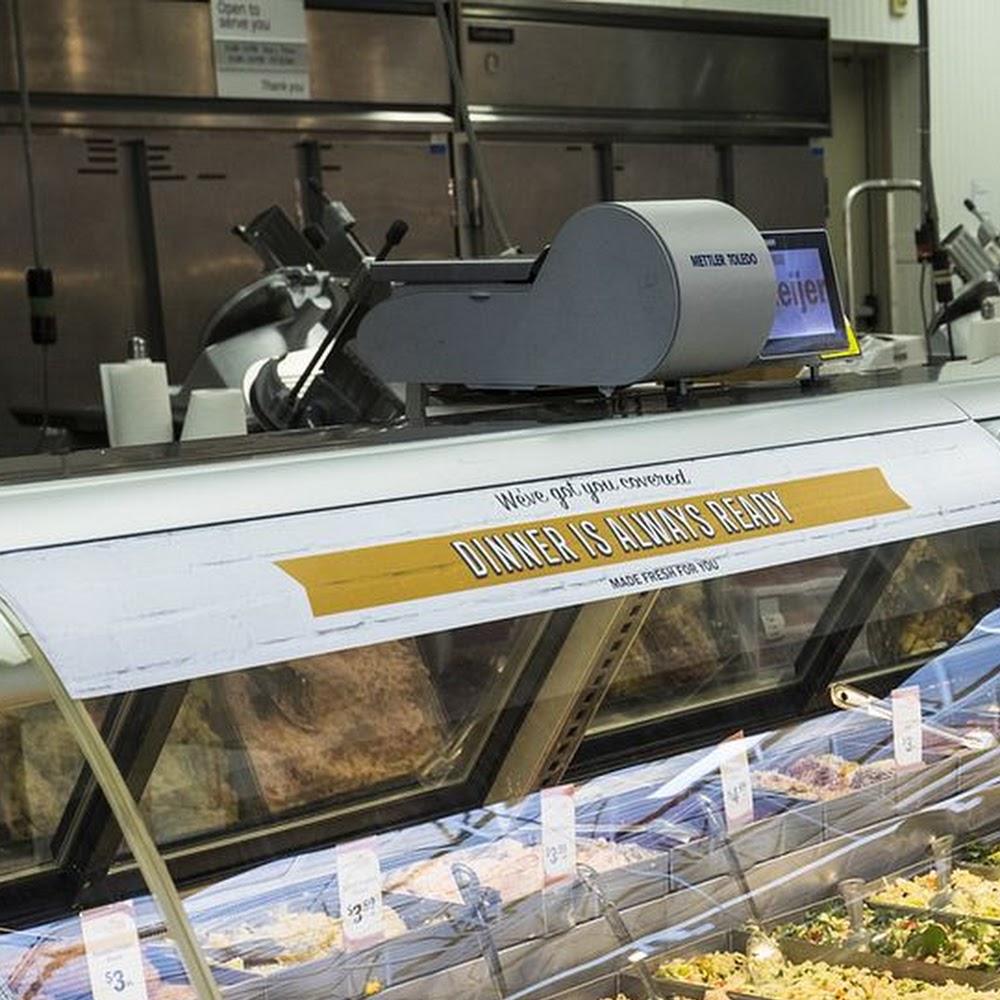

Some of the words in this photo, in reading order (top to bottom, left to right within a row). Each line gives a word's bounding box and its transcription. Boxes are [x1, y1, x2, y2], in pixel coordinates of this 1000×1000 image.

[217, 0, 246, 15] Open
[248, 3, 260, 16] to
[219, 18, 249, 29] serve
[251, 19, 271, 34] you
[261, 79, 288, 92] Thank
[288, 82, 305, 95] you
[690, 253, 726, 268] METTLER
[727, 252, 759, 267] TOLEDO
[776, 270, 826, 314] eijer
[494, 485, 549, 513] We've
[550, 476, 582, 511] got
[582, 480, 619, 504] you
[450, 523, 580, 579] DINNER
[570, 519, 613, 558] IS
[603, 502, 717, 552] ALWAYS
[703, 488, 796, 535] READY
[608, 573, 643, 590] MADE
[642, 564, 678, 584] FRESH
[676, 561, 699, 577] FOR
[697, 556, 720, 573] YOU
